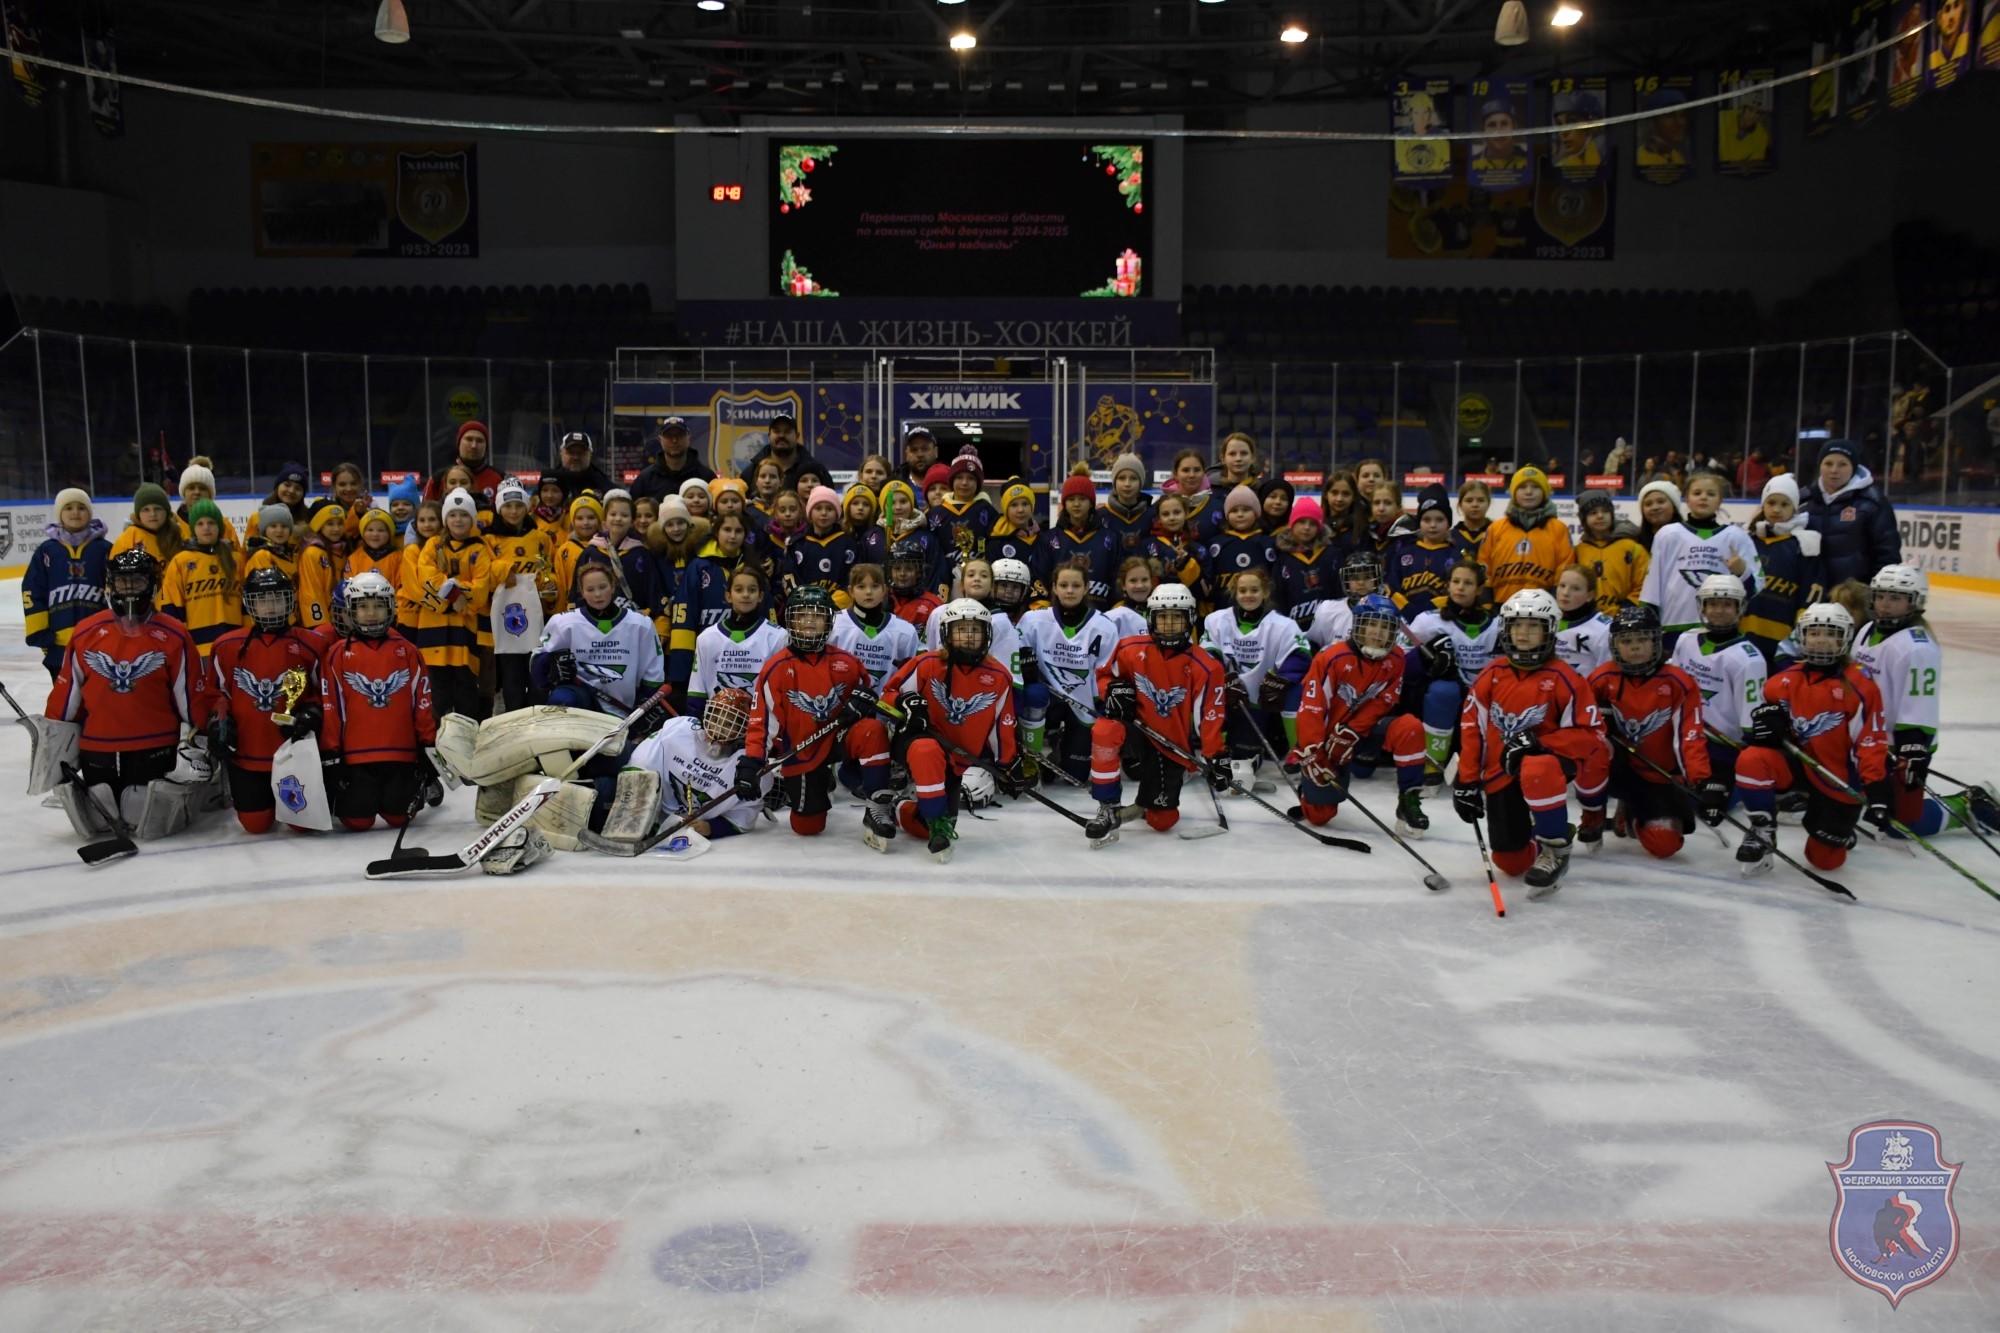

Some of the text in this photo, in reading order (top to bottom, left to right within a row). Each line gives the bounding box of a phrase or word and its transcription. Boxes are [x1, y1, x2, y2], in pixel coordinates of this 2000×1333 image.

[1634, 75, 1660, 93] 16
[1719, 69, 1742, 84] 14
[1398, 81, 1409, 95] 3
[1550, 78, 1574, 94] 13
[859, 211, 1065, 224] Первенство Московской области
[856, 225, 1069, 238] по хоккею среди девушек 2024-2025
[401, 243, 470, 256] 1953-2023
[958, 240, 1019, 251] надежды"
[1536, 246, 1606, 258] 1953-2023
[724, 316, 1133, 347] #НАША ЖИЗНЬ-ХОККЕЙ
[927, 384, 1004, 392] ХОККЕЙНЫЙ КЛУБ
[909, 392, 1021, 409] ХИМИК
[1899, 520, 1962, 551] RIDGE
[311, 603, 323, 621] 8
[671, 603, 687, 624] 15
[855, 643, 885, 652] СШОР
[1055, 642, 1082, 653] СШОР
[1011, 652, 1021, 675] 8
[1306, 680, 1317, 699] 3
[1909, 668, 1936, 696] 12
[1214, 686, 1224, 706] 2
[1585, 704, 1601, 727] 2
[1431, 738, 1447, 750] 24
[468, 802, 532, 860] SUPREME
